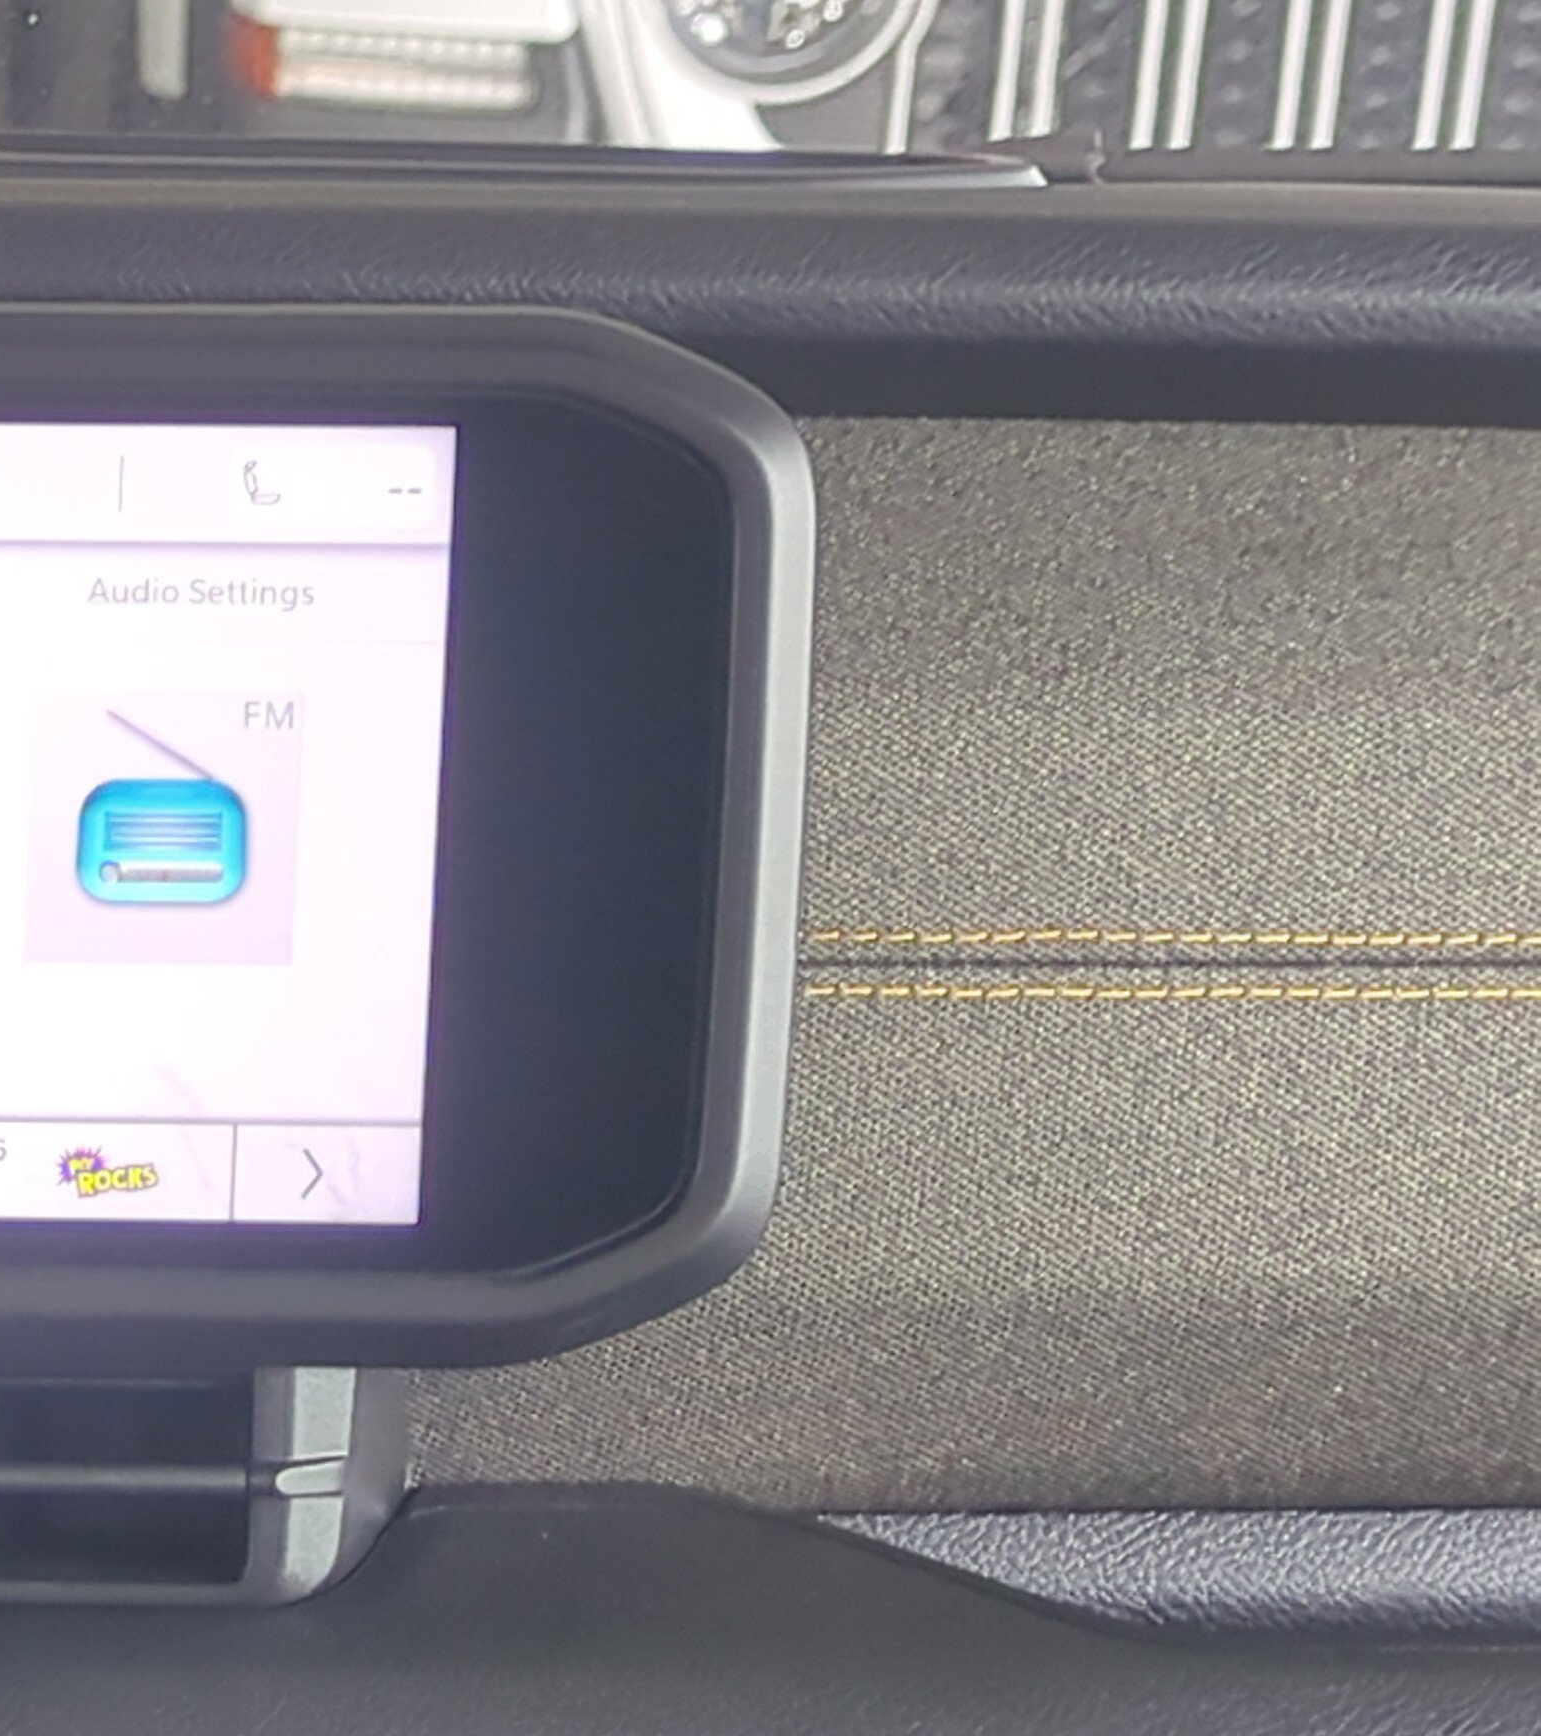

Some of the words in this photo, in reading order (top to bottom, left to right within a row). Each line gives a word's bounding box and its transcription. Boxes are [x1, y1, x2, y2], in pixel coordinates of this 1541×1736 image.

[88, 577, 180, 605] Audio
[189, 577, 315, 612] Settings
[242, 700, 295, 730] FM
